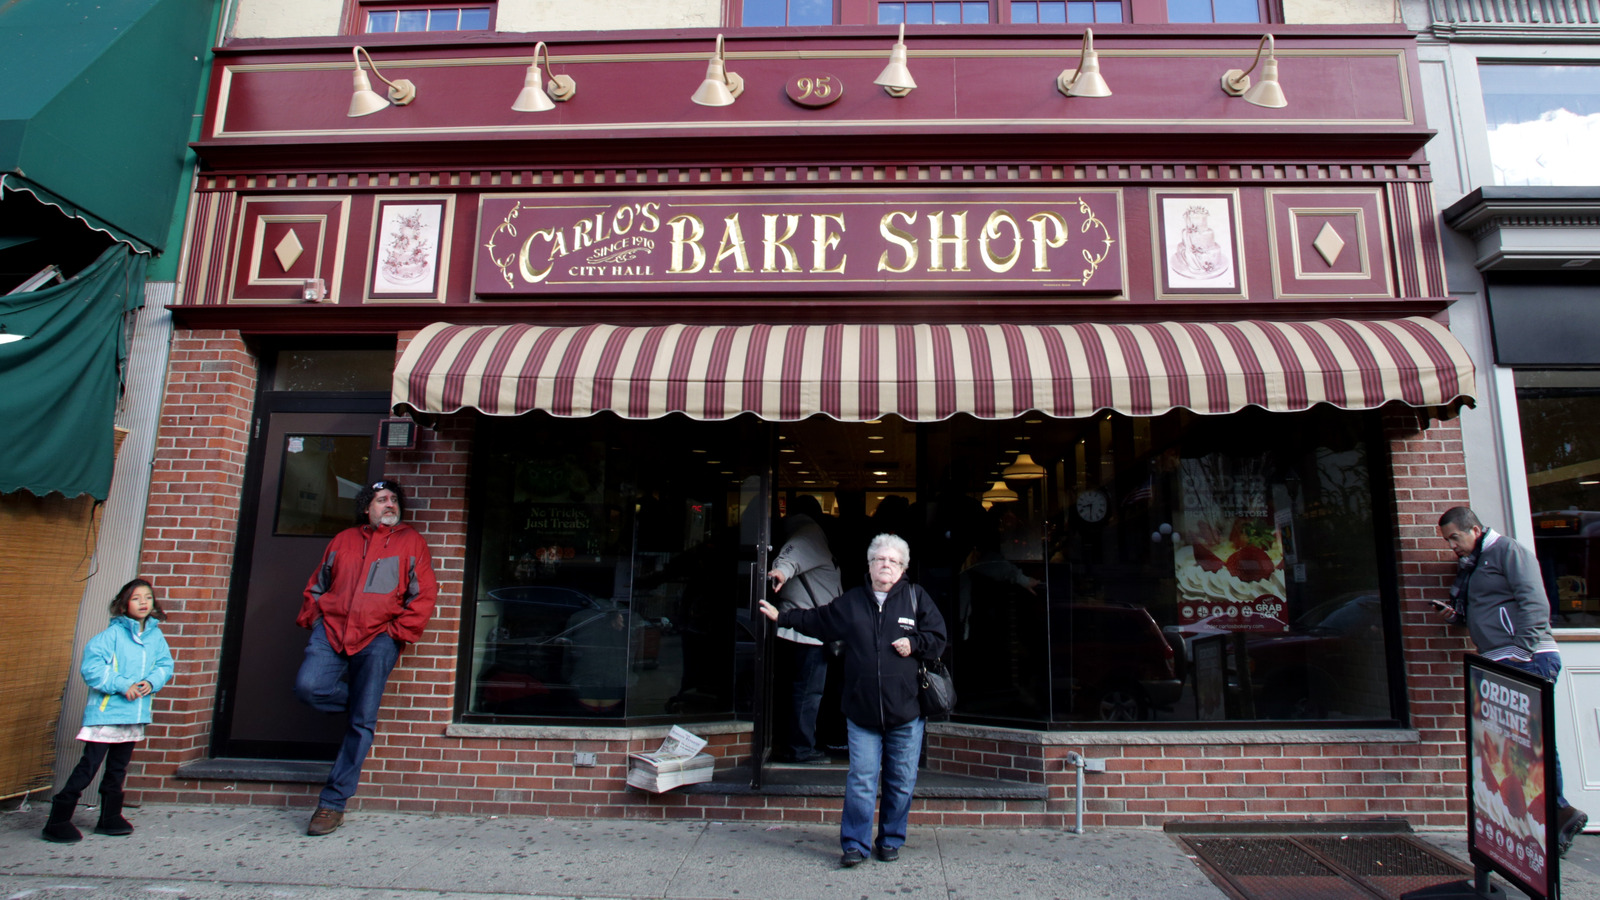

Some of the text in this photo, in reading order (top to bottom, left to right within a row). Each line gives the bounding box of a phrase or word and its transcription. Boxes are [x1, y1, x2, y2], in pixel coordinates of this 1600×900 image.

[797, 76, 831, 100] 95
[518, 201, 1069, 283] CARLO'S BAKE SHOP
[592, 235, 655, 259] SINCE 1910
[568, 265, 654, 276] CITY HALL
[1182, 474, 1266, 491] ODER
[530, 507, 546, 518] No
[1224, 510, 1268, 518] IN-STORE
[523, 518, 590, 531] Just Treats!
[1255, 603, 1282, 612] GRAB
[1480, 679, 1530, 715] ORDER
[1525, 846, 1544, 867] GRAB
